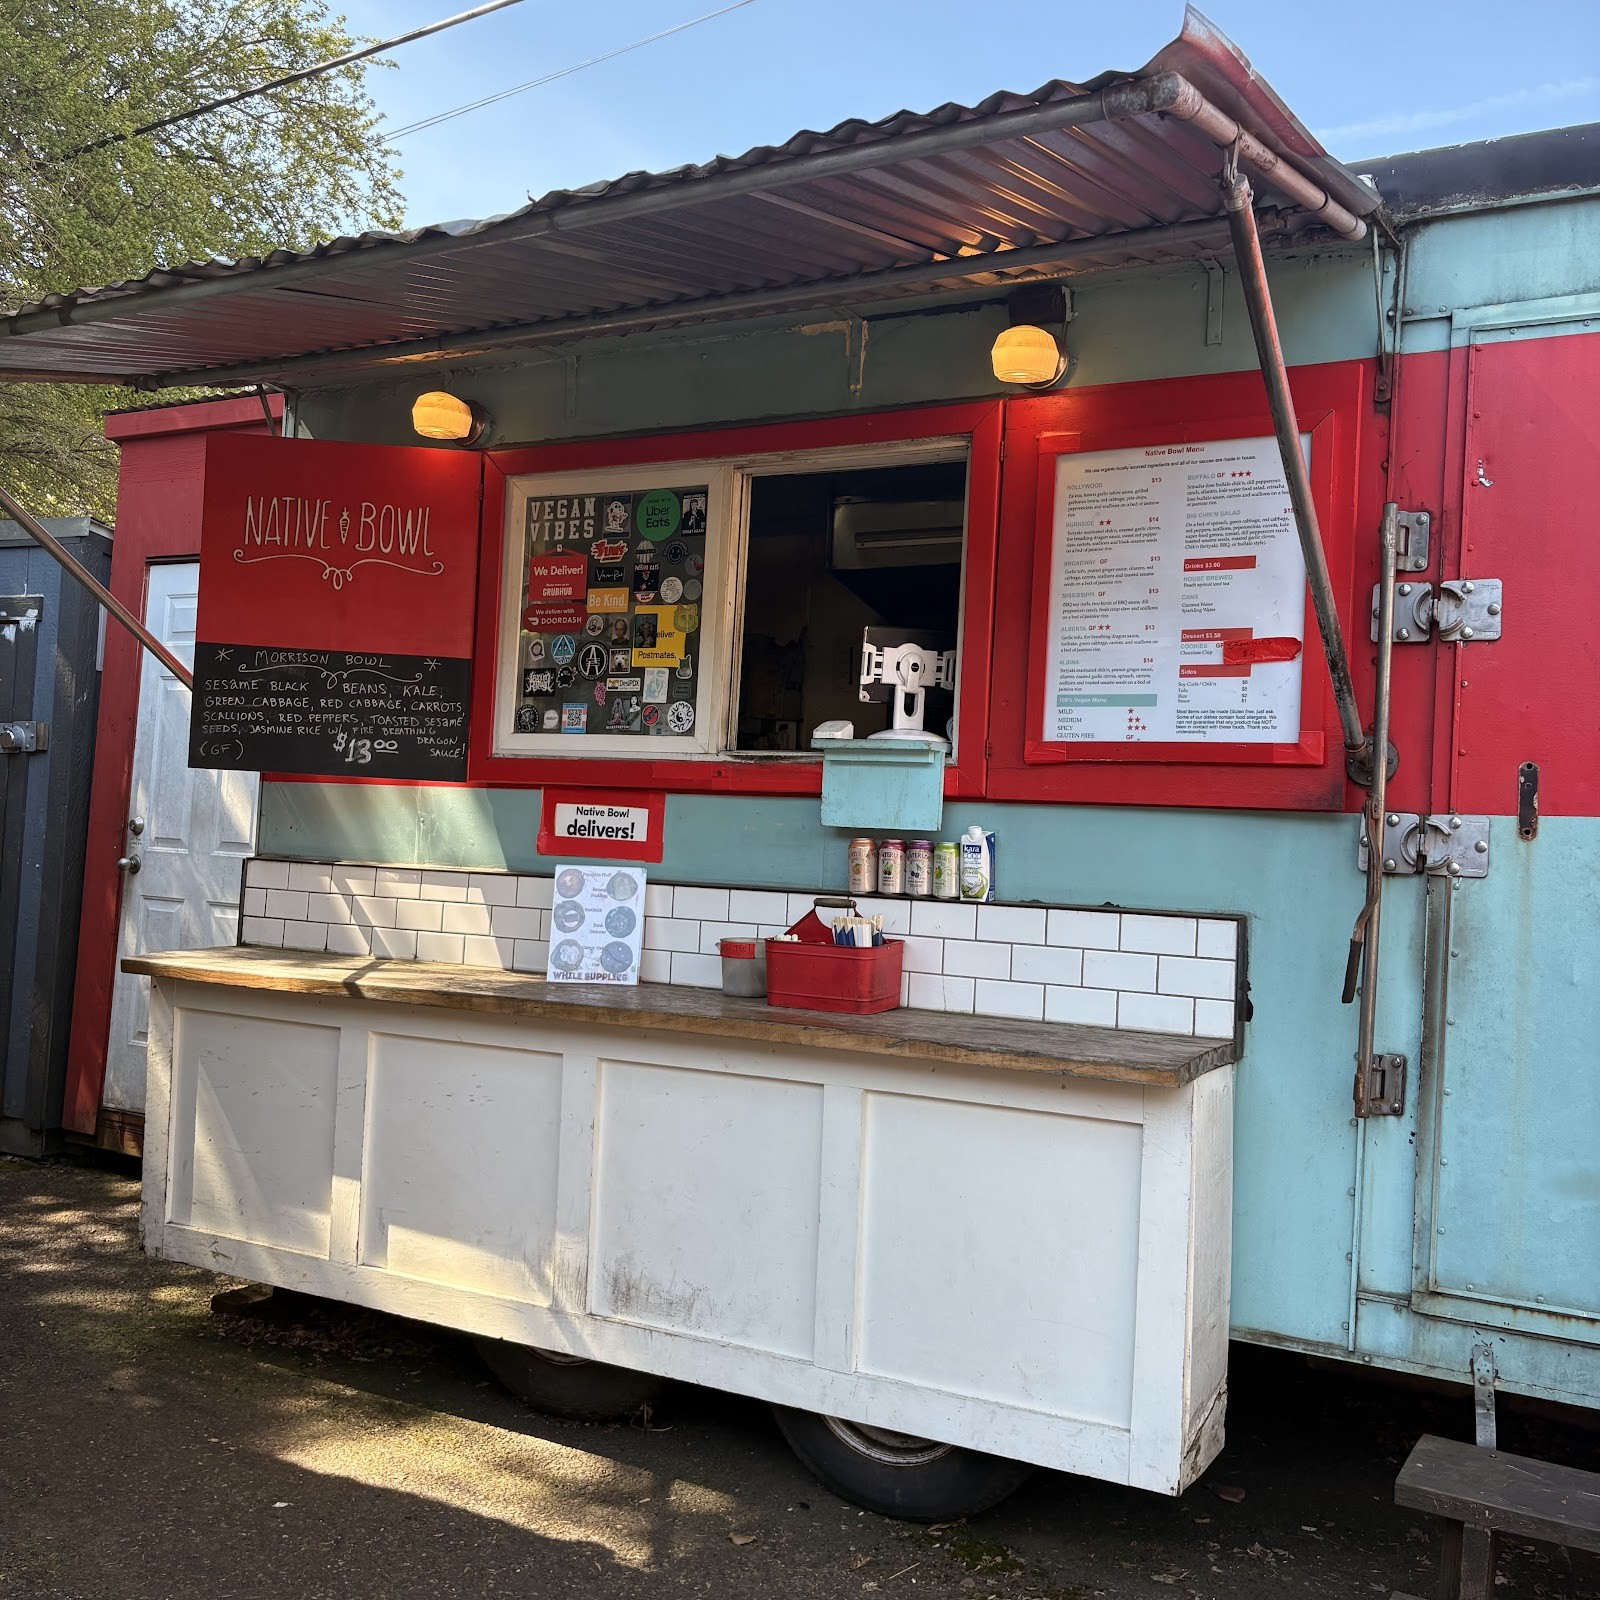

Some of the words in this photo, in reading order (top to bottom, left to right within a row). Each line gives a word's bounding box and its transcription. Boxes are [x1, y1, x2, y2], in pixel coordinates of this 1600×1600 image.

[531, 498, 596, 520] VEGAN
[647, 506, 670, 516] Uber
[245, 496, 331, 549] NATIVE
[355, 502, 434, 556] BOWL
[646, 518, 670, 528] Eats
[530, 519, 594, 541] VIBES
[534, 567, 548, 576] We
[551, 565, 583, 575] Deliver!
[543, 588, 572, 596] GRUBHUB
[590, 594, 600, 606] Be
[604, 594, 626, 606] Kind.
[256, 650, 329, 666] MORRISON
[346, 655, 391, 667] BOWL
[270, 681, 309, 691] BLACK
[343, 683, 392, 698] BEANS,
[403, 686, 442, 698] KALE,
[206, 696, 244, 707] GREEN
[253, 697, 314, 711] CABBAGE,
[320, 698, 343, 708] RED
[349, 699, 406, 712] CABBAGE,
[204, 711, 269, 724] SCALLIONS,
[279, 714, 302, 722] RED
[308, 713, 364, 726] PEPPERS,
[370, 715, 419, 726] TOASTED
[202, 724, 241, 734] SEEDS,
[250, 726, 292, 734] JASMINE
[297, 725, 321, 734] RICE
[417, 736, 457, 744] DRAGON
[430, 743, 465, 759] SAUCE!
[576, 806, 605, 817] Native
[607, 808, 630, 818] Bowl
[567, 819, 635, 839] delivers!
[553, 971, 582, 980] WHILE
[584, 972, 629, 982] SUPPLIES
